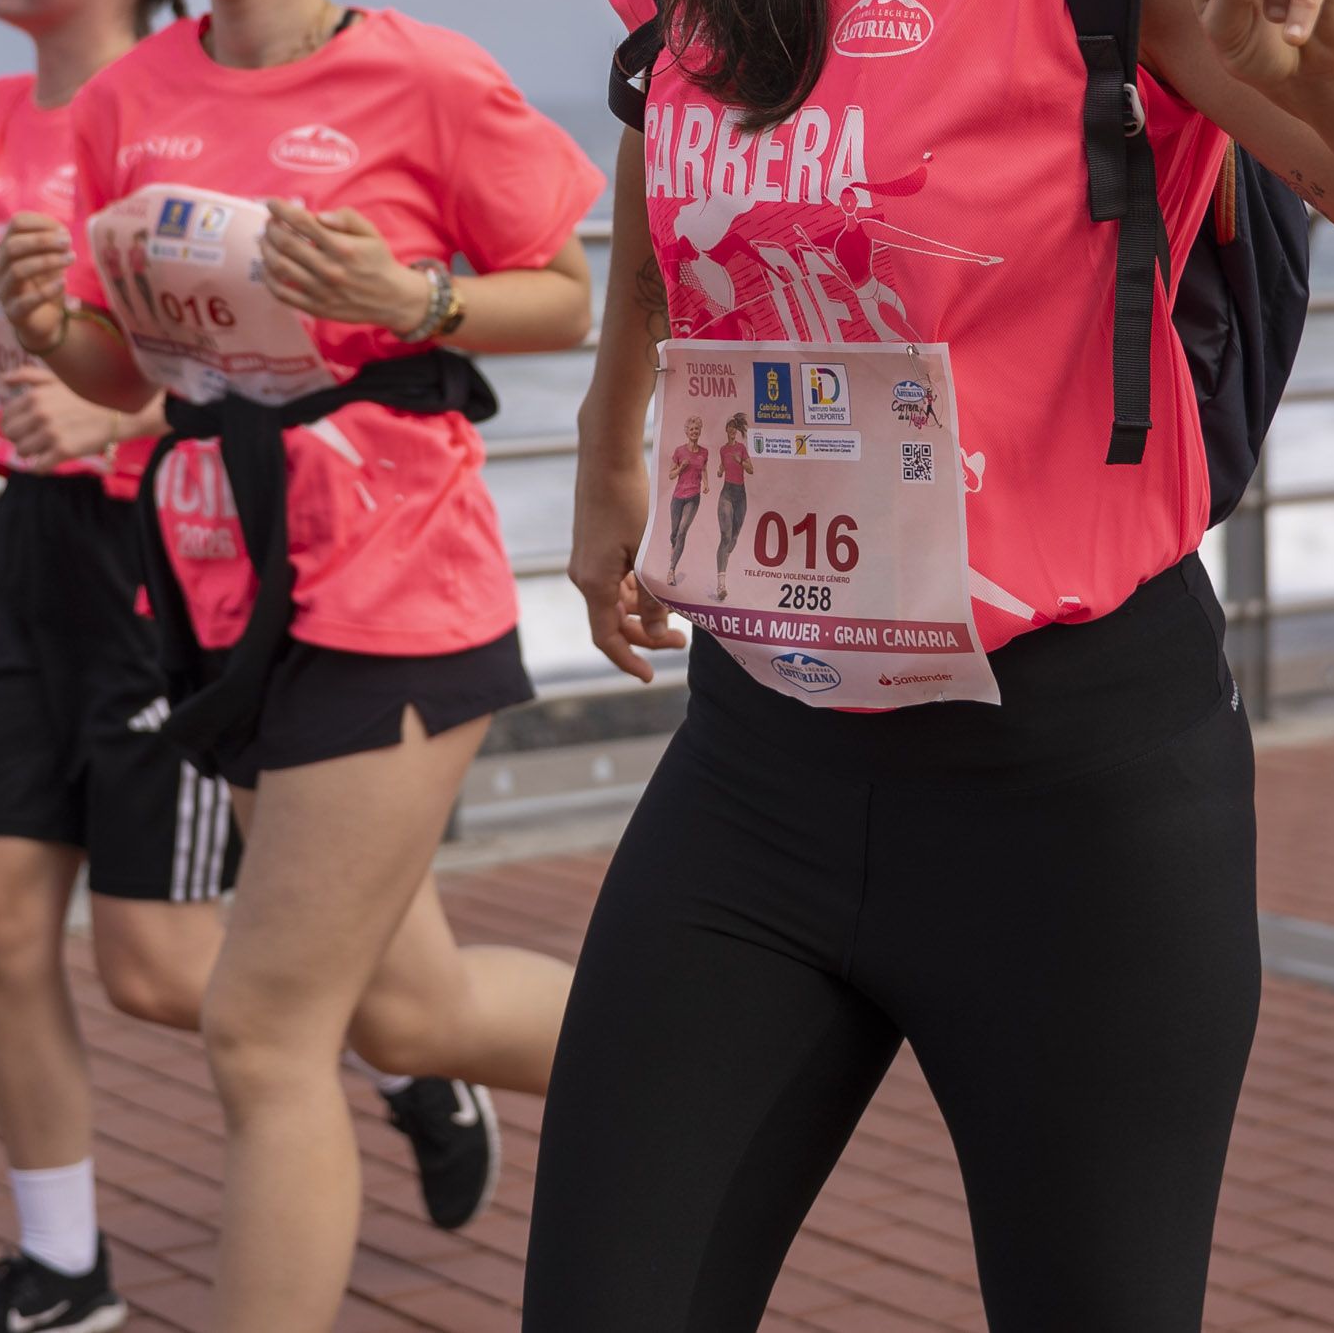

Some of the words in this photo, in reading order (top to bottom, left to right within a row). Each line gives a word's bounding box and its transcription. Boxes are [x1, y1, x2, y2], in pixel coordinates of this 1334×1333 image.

[160, 290, 236, 328] 016
[686, 362, 698, 375] TU
[699, 363, 736, 376] DORSAL
[688, 376, 738, 398] SUMA
[754, 511, 859, 572] 016
[744, 569, 782, 579] TELÉFONO
[783, 572, 816, 582] VIOLENCIA
[817, 574, 825, 582] DE
[826, 574, 850, 584] GÉNERO
[778, 583, 832, 611] 2858
[721, 615, 740, 635] DE
[745, 618, 764, 637] LA
[770, 620, 821, 642] MUJER
[834, 626, 878, 646] GRAN
[883, 628, 960, 648] CANARIA
[777, 663, 836, 684] ASTURIANA
[892, 673, 954, 685] Santander
